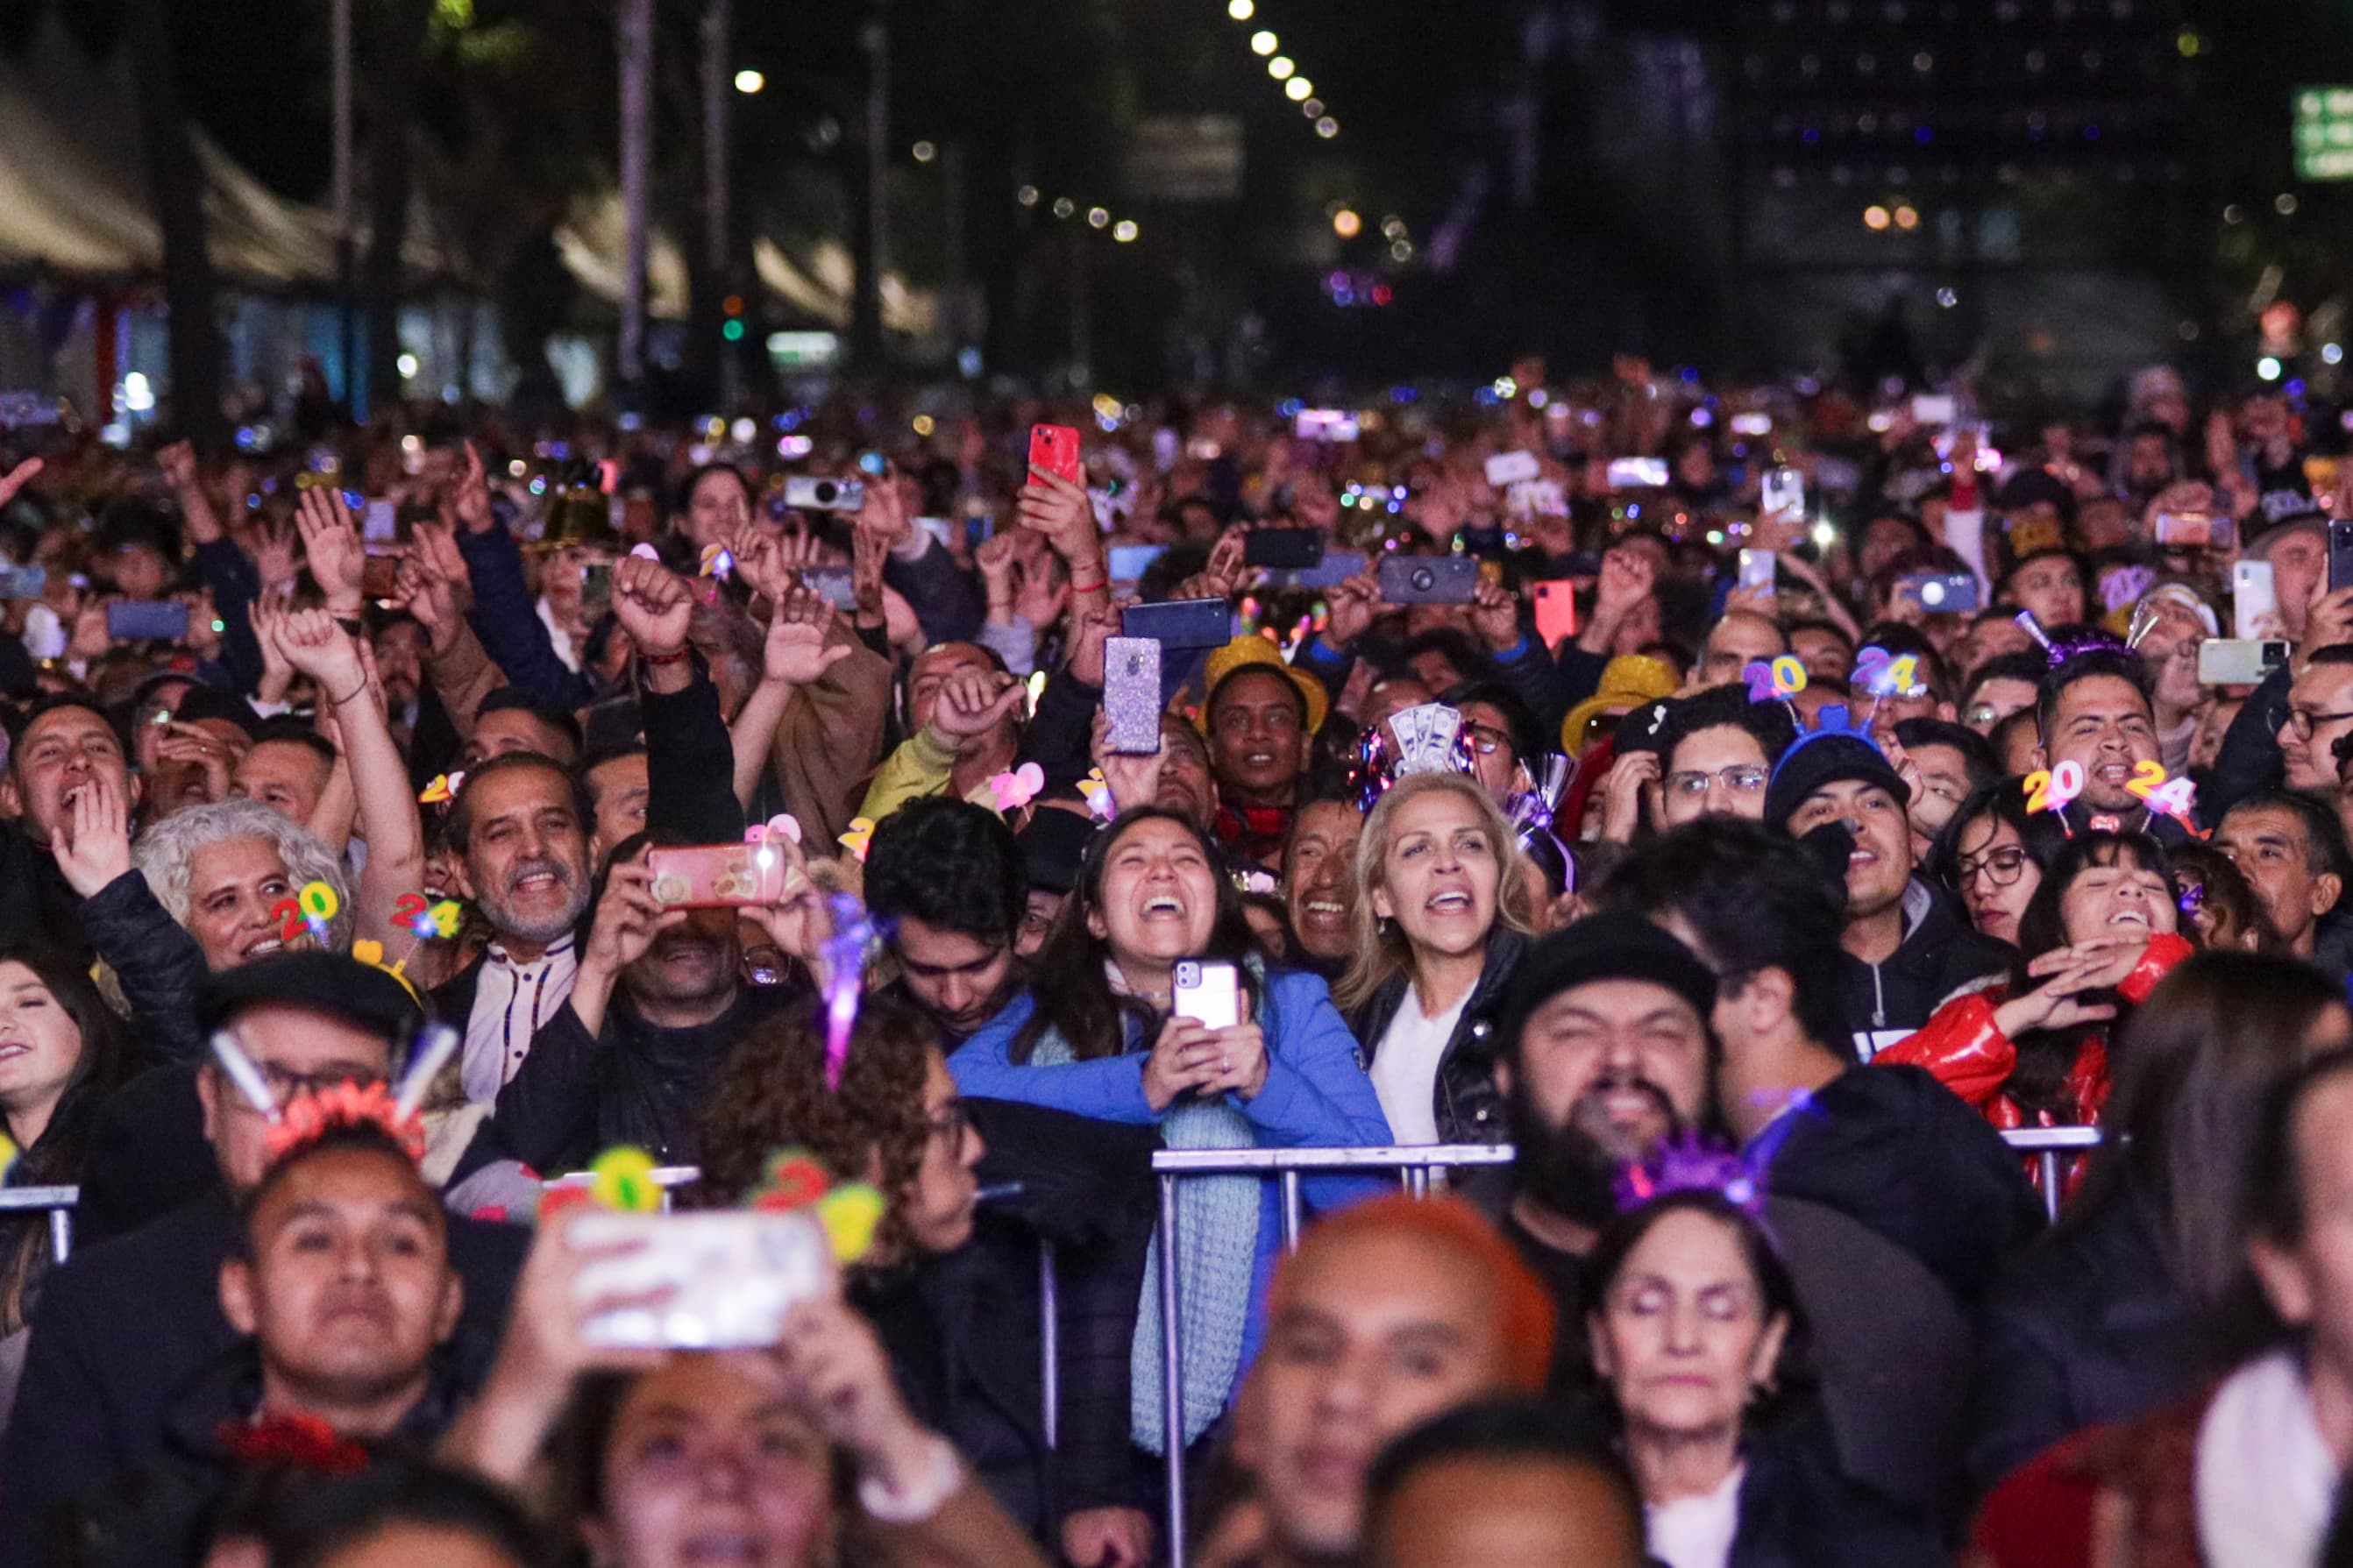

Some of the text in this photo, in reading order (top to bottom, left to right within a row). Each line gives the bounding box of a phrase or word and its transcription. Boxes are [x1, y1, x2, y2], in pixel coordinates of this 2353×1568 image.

[1743, 646, 1918, 704] 20 24
[2022, 759, 2197, 817] 20 24
[270, 880, 462, 942] 20 24
